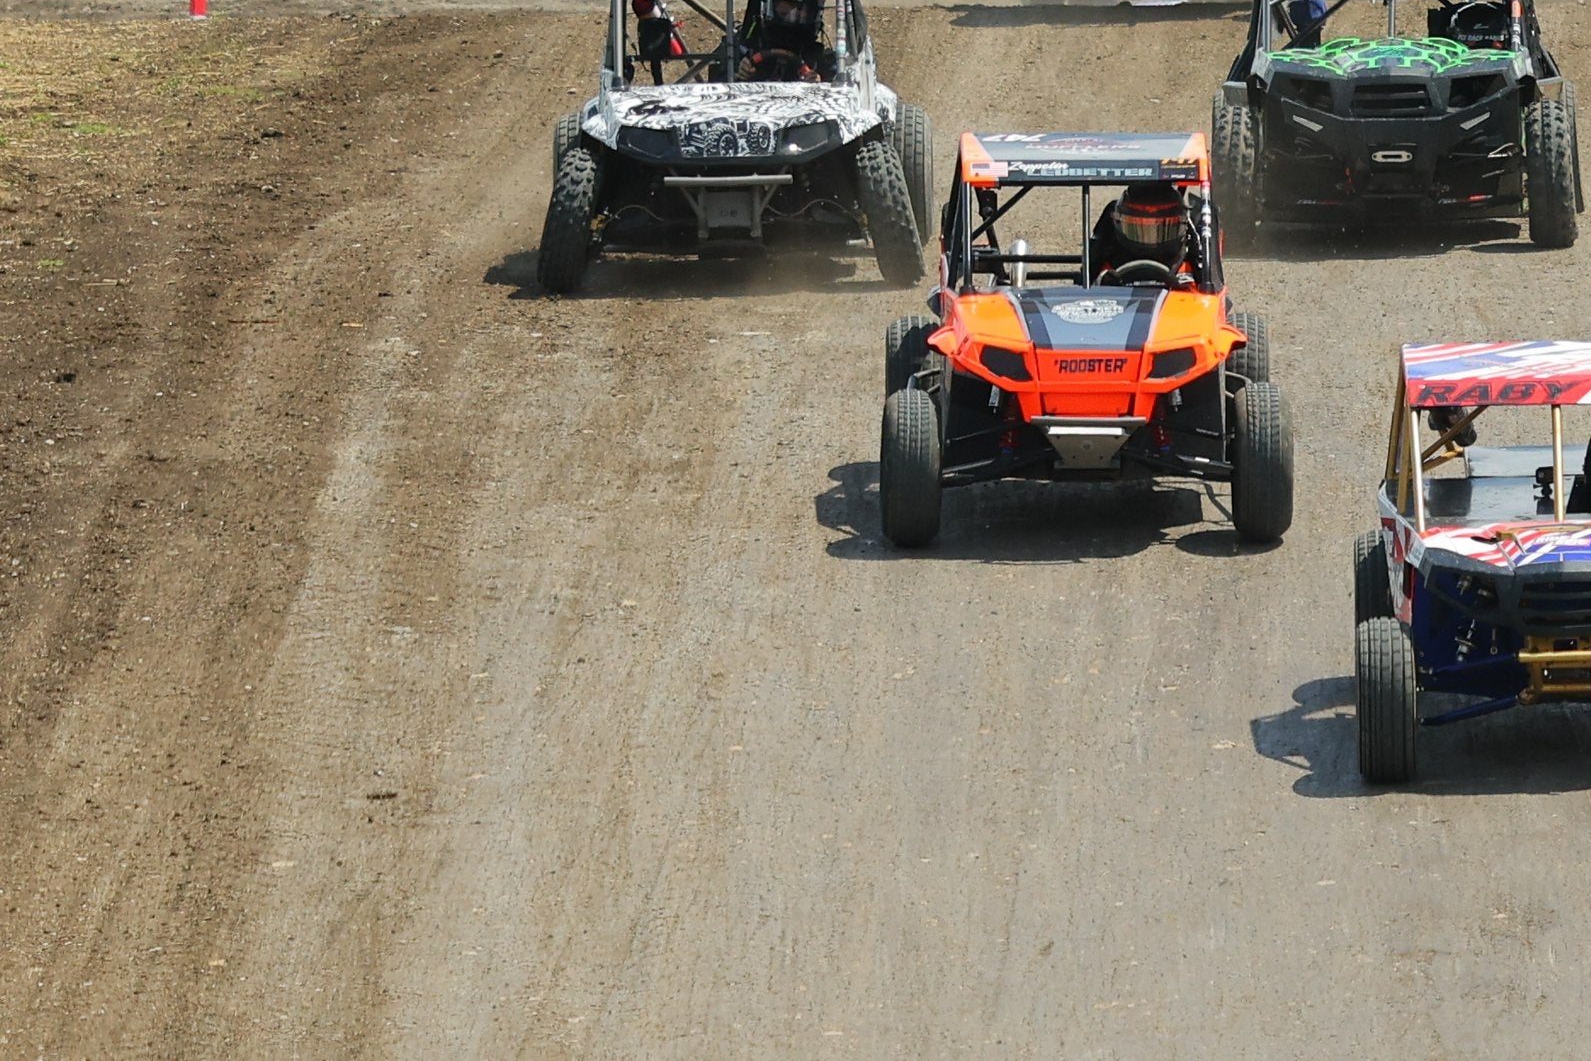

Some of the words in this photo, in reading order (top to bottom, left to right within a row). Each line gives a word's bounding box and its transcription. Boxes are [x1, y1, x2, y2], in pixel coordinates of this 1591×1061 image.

[1008, 161, 1070, 173] Zeppelin
[1027, 168, 1153, 177] LEDBETTER
[1416, 380, 1588, 404] RABY
